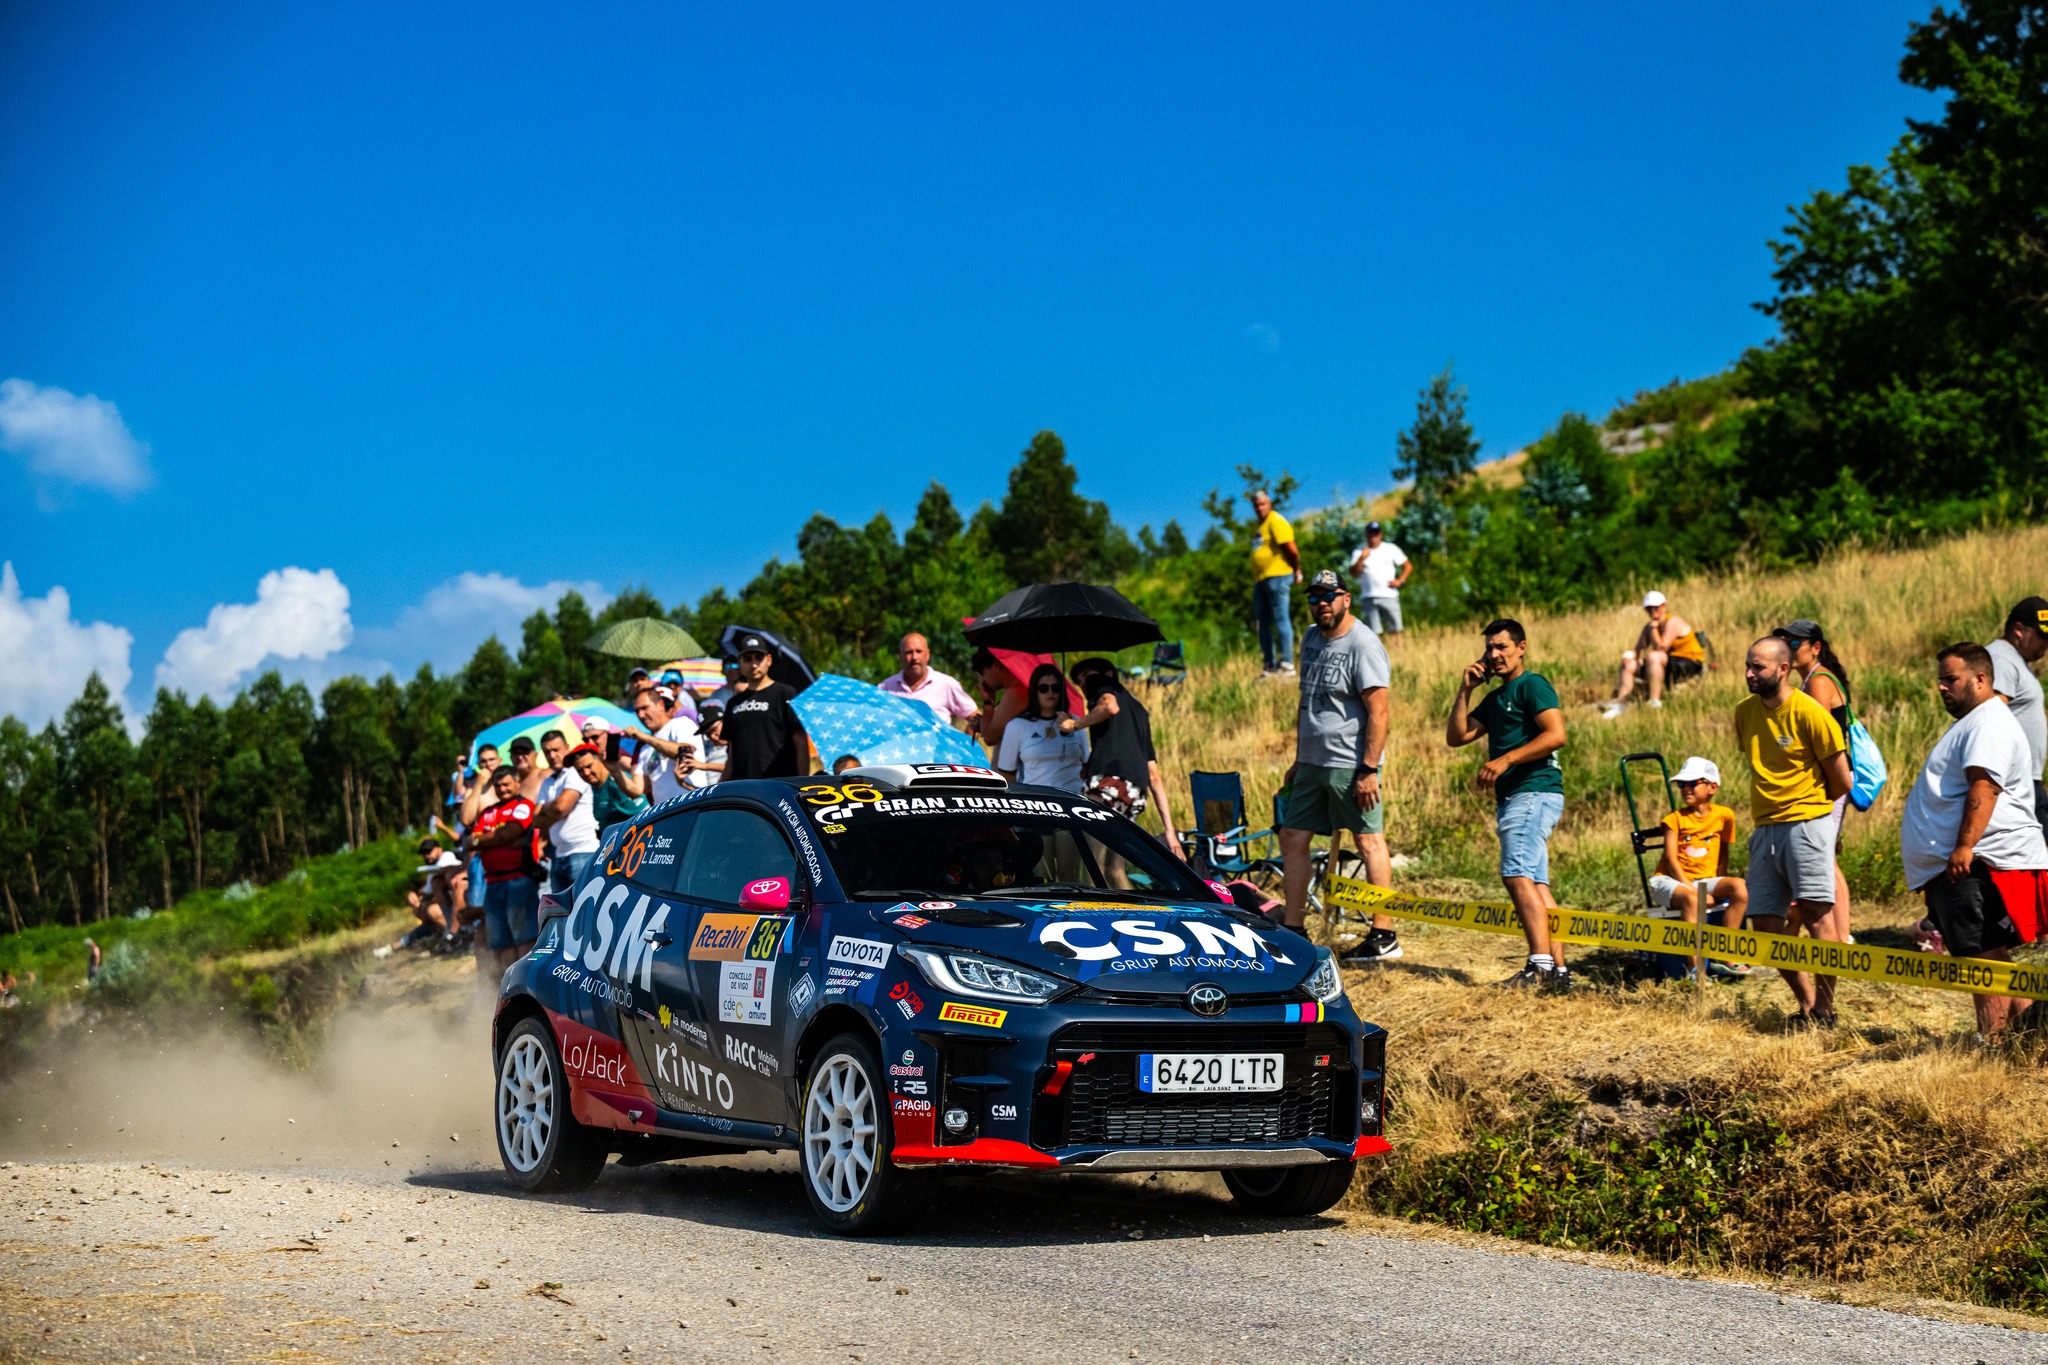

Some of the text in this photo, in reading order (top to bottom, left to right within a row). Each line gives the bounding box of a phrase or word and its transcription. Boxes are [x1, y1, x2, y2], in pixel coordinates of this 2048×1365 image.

[916, 764, 992, 776] GR
[800, 783, 884, 805] 36
[874, 796, 1065, 813] GRAN TURISMO
[606, 824, 653, 878] 36
[655, 835, 673, 848] Sanz
[648, 851, 675, 865] Larrosa
[1335, 881, 1382, 906] PUBLICO
[1416, 901, 1466, 921] PUBLICO
[1474, 906, 1506, 928] ZONA
[563, 876, 671, 992] CSM
[695, 925, 750, 949] Recalvi
[751, 921, 781, 959] 36
[1569, 916, 1651, 943] ZONA PUBLICO
[835, 941, 884, 963] TOYOTA
[1039, 920, 1296, 965] CSM
[1662, 926, 1757, 957] ZONA PUBLICO
[1111, 956, 1266, 972] GRUP AUTOMOCIÓ
[1770, 940, 1871, 972] ZONA PUBLICO
[729, 971, 752, 981] CONCELLO
[828, 966, 855, 977] TERRASSA
[1885, 954, 1993, 987] ZONA PUBLICO
[552, 964, 633, 1008] GRUP AUTOMOCIÓ
[738, 982, 748, 990] VIGO
[944, 1005, 1001, 1025] PIRELLI
[672, 1013, 678, 1026] la
[680, 1019, 708, 1041] moderna
[725, 1033, 757, 1071] RACC
[757, 1048, 779, 1072] Mobility
[758, 1063, 771, 1077] Club
[889, 1064, 924, 1076] Castrol
[1143, 1058, 1277, 1085] E 6420 LTR
[902, 1099, 931, 1110] PAGID
[991, 1105, 1017, 1117] CSM
